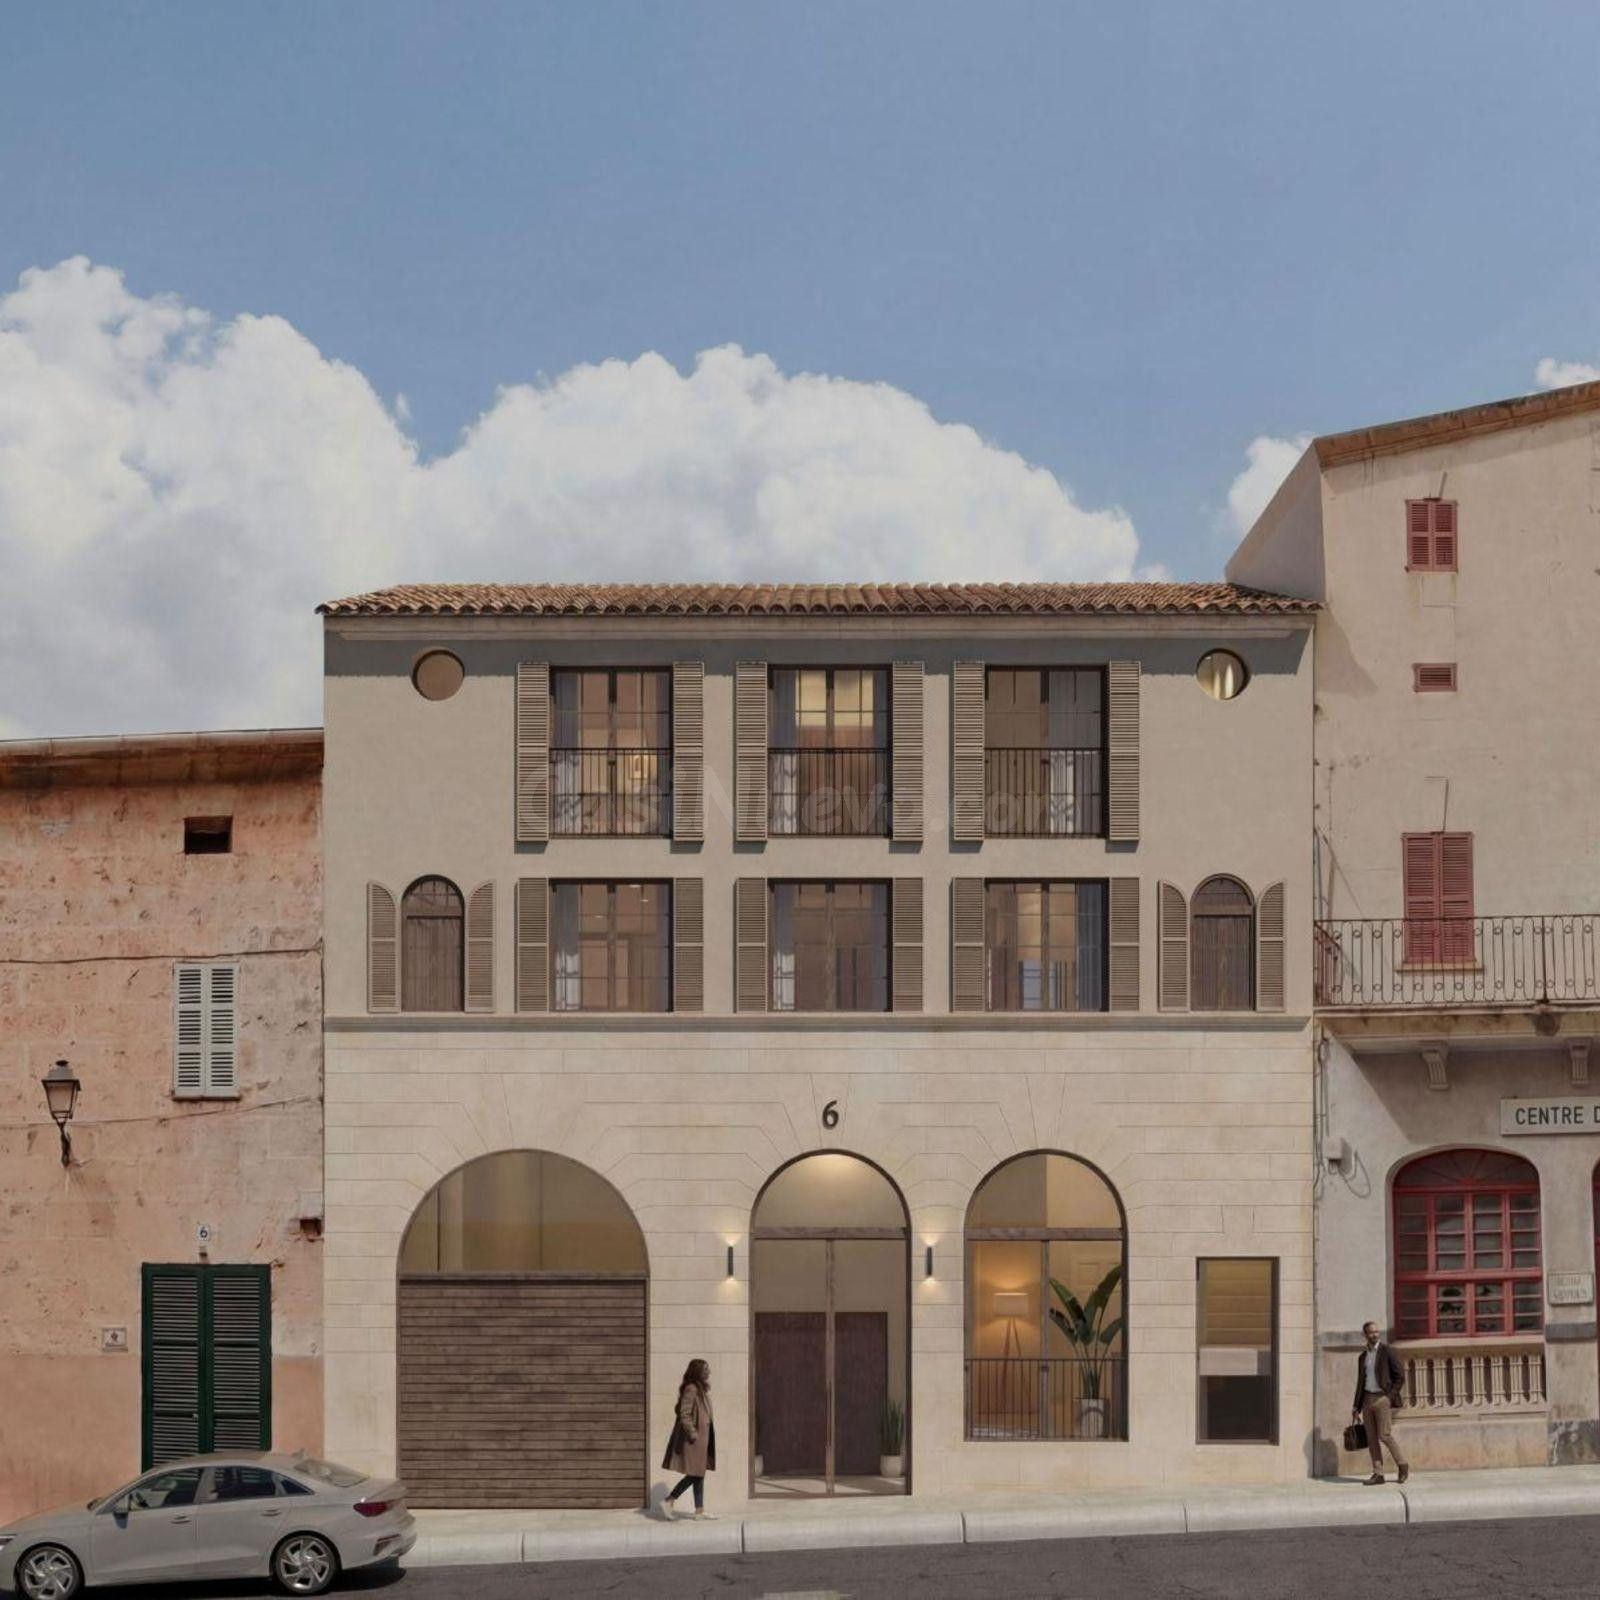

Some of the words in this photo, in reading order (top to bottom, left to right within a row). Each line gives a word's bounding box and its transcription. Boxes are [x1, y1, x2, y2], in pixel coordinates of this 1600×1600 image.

[822, 1099, 839, 1130] 6
[1515, 1106, 1584, 1125] CENTRE
[200, 1226, 208, 1239] 6
